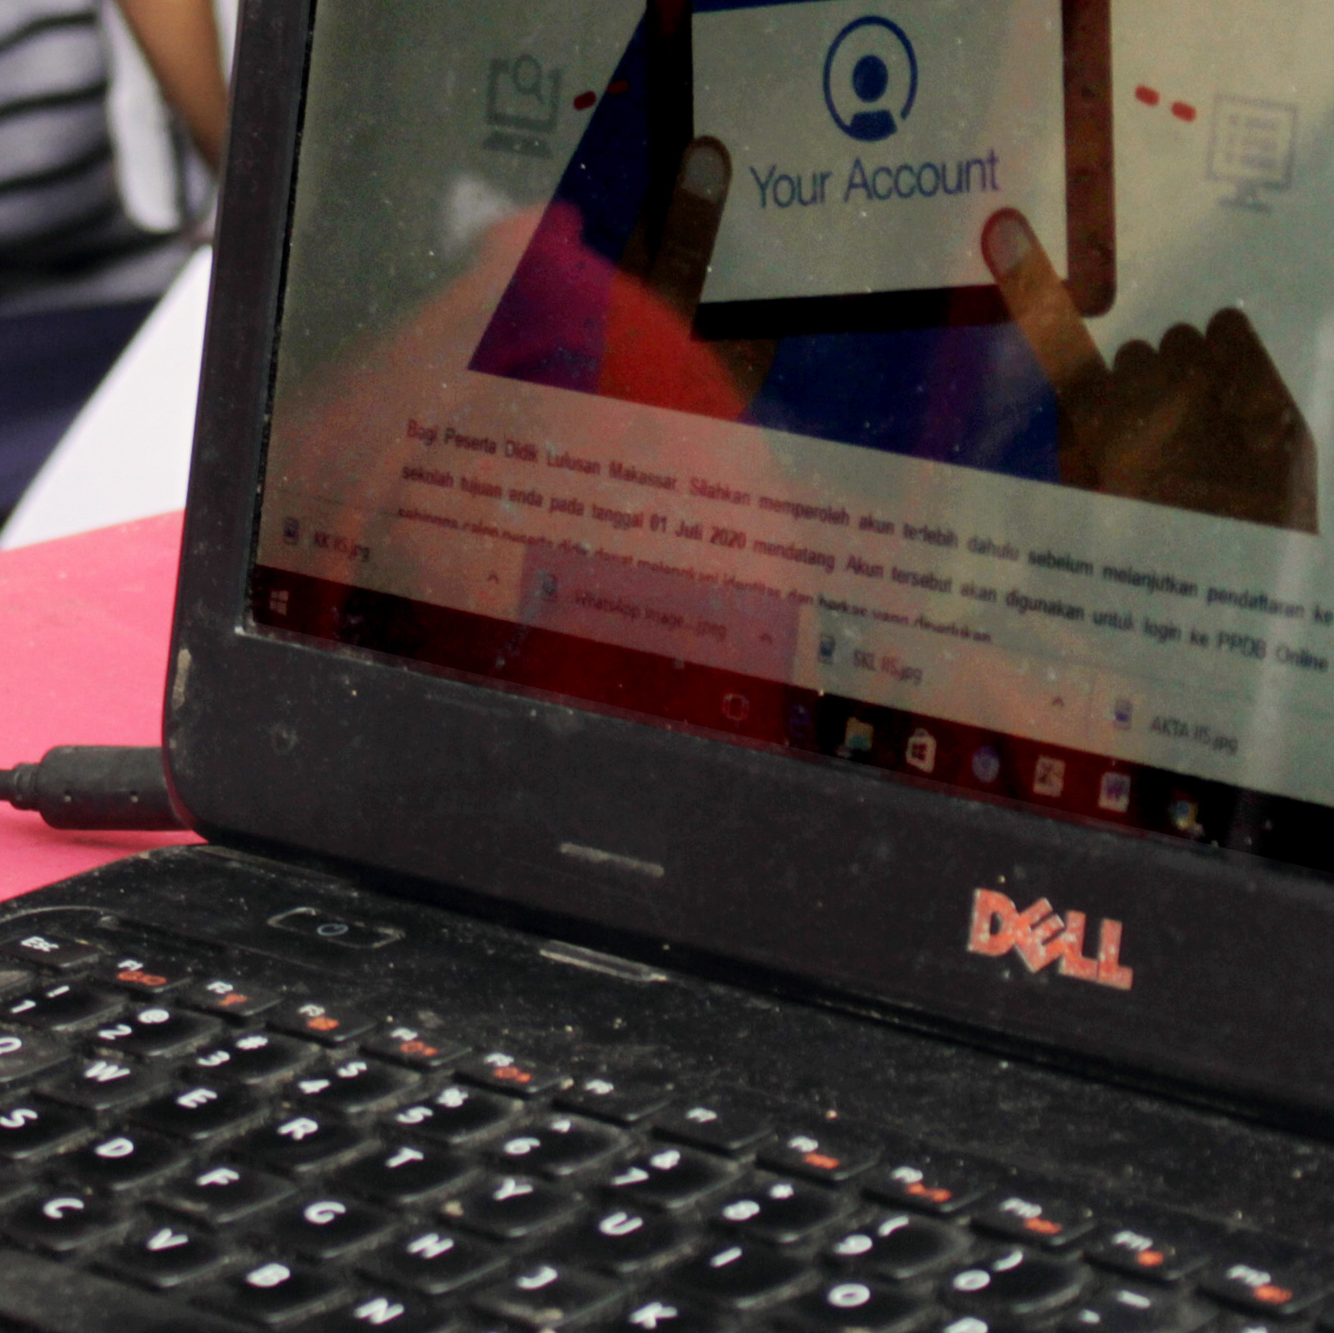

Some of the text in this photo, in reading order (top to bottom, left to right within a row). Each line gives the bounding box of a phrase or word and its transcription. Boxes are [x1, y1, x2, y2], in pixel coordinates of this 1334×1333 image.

[750, 148, 1001, 210] Your Account
[443, 427, 498, 457] Peserta
[966, 887, 1134, 991] DELL
[42, 1196, 85, 1219] C
